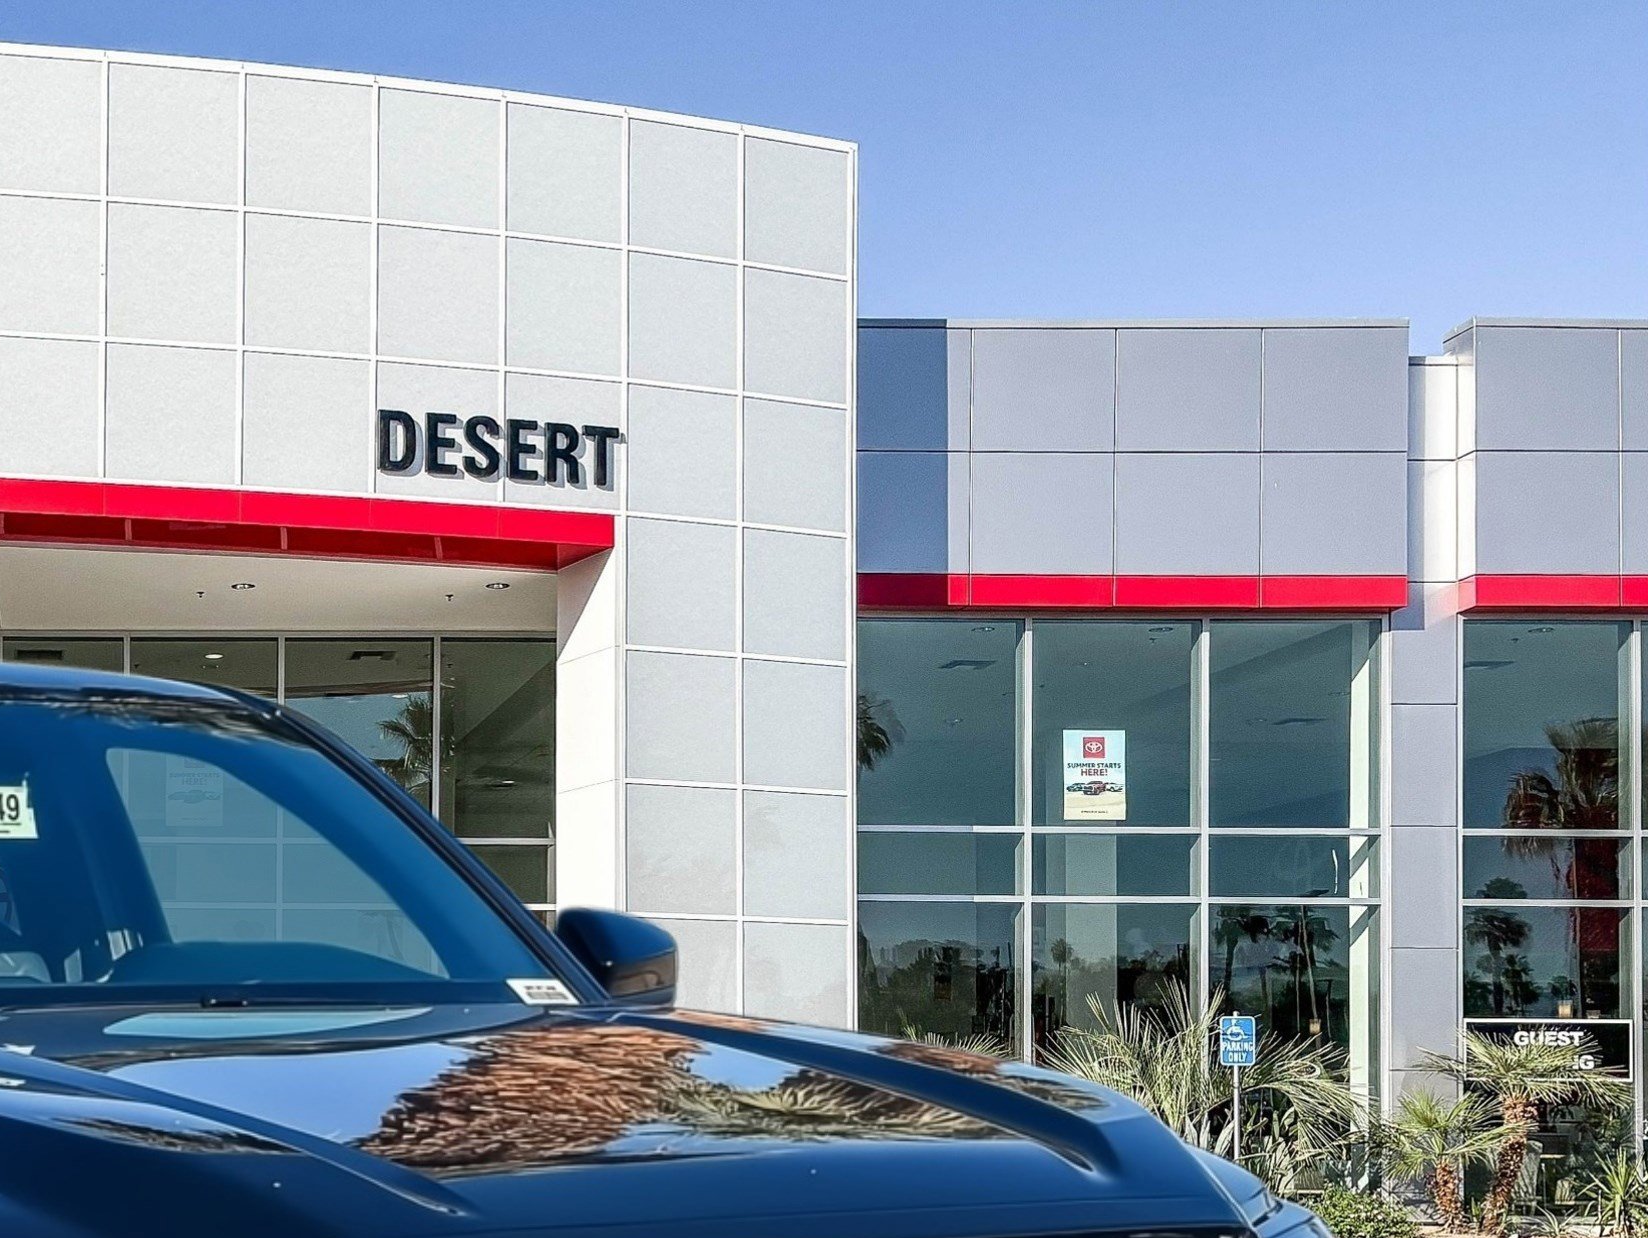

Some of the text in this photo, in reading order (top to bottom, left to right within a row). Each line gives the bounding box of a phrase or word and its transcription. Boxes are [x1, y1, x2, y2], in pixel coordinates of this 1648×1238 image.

[377, 409, 620, 487] DESERT
[1080, 768, 1108, 776] HERE!
[1513, 1031, 1584, 1047] GUEST
[1222, 1041, 1253, 1051] PARKING
[1228, 1052, 1248, 1062] ONLY
